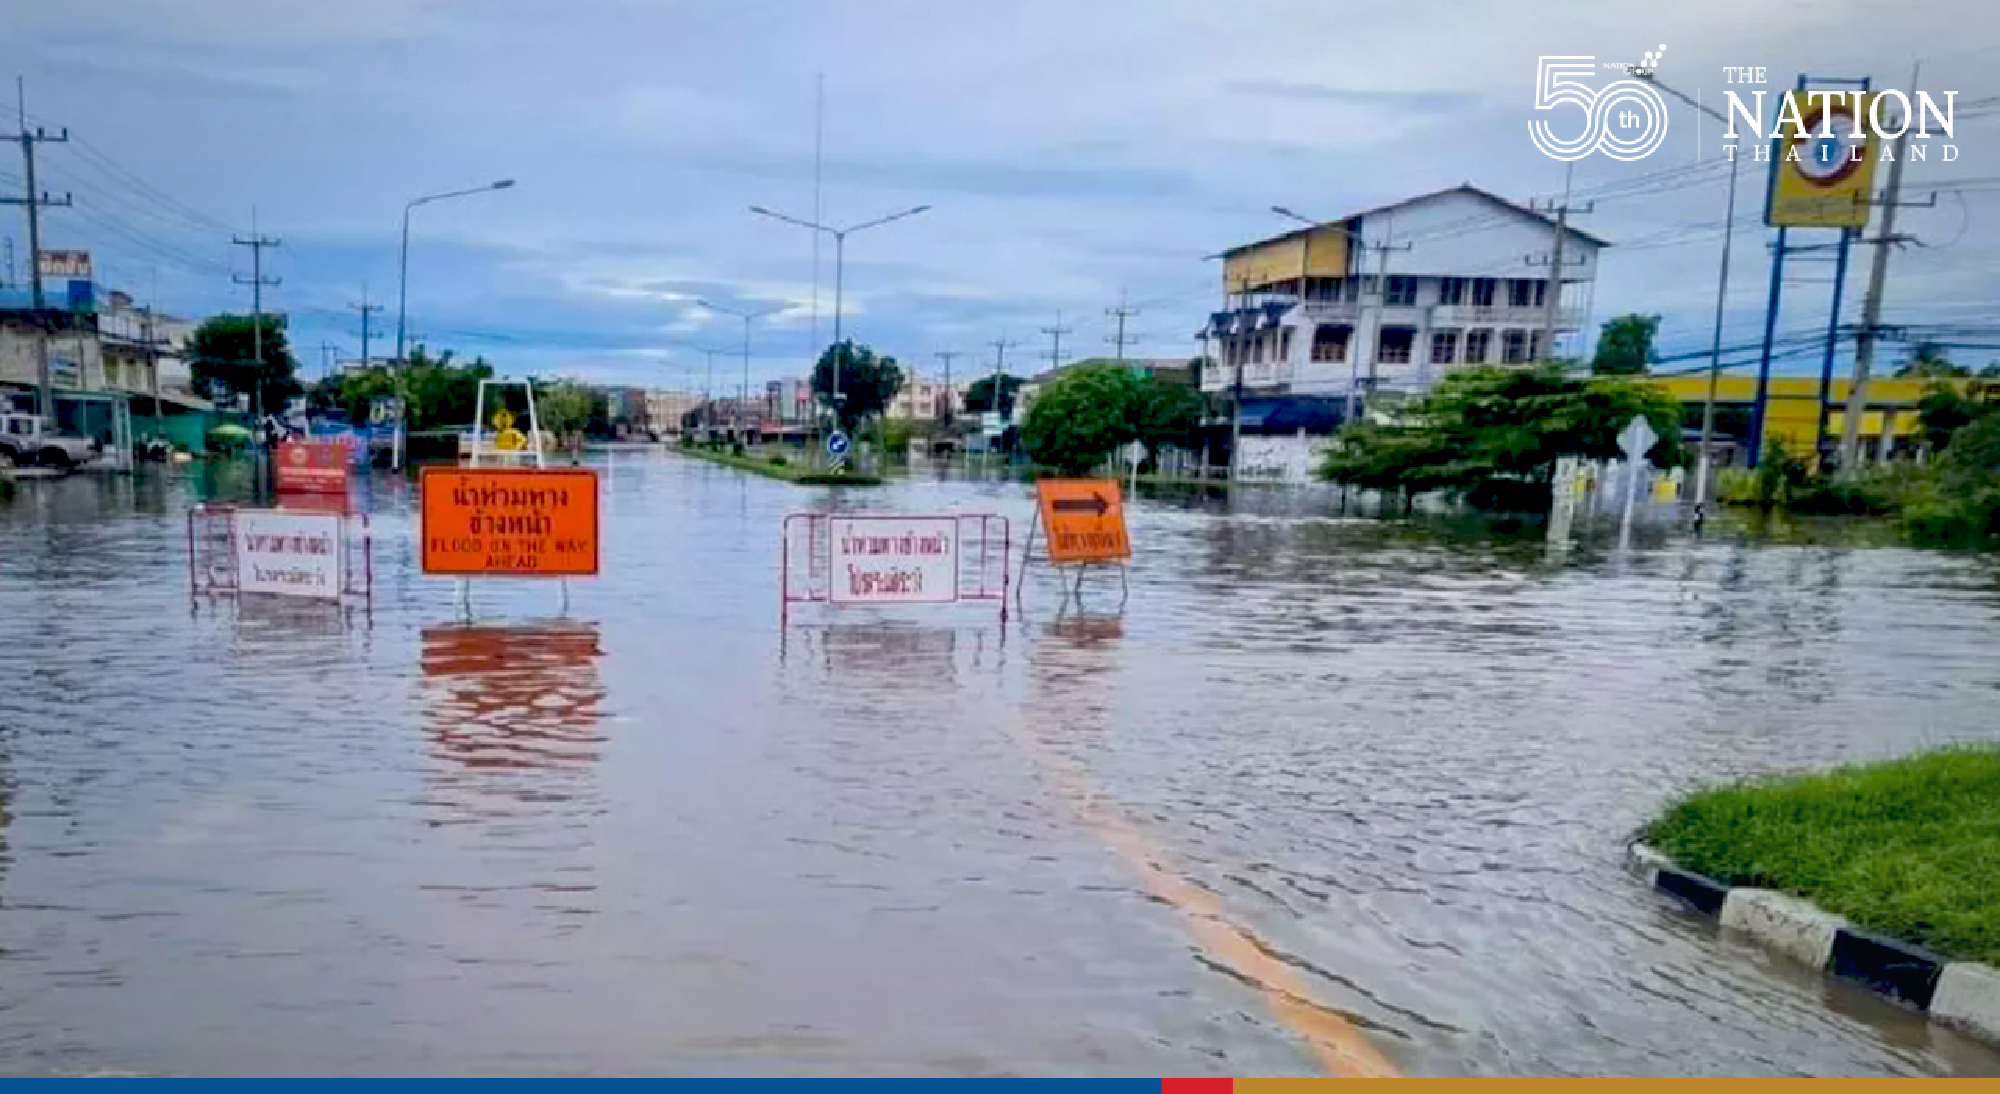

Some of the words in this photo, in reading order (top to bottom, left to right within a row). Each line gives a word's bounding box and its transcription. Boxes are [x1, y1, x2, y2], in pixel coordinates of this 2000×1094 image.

[453, 475, 569, 506] น้ำท่วมทาง
[470, 508, 553, 535] ข้างหน้า
[430, 538, 483, 553] FLOOD
[490, 538, 511, 553] ON
[518, 538, 546, 553] THE
[555, 539, 588, 554] WAY
[486, 555, 538, 568] AHEAD
